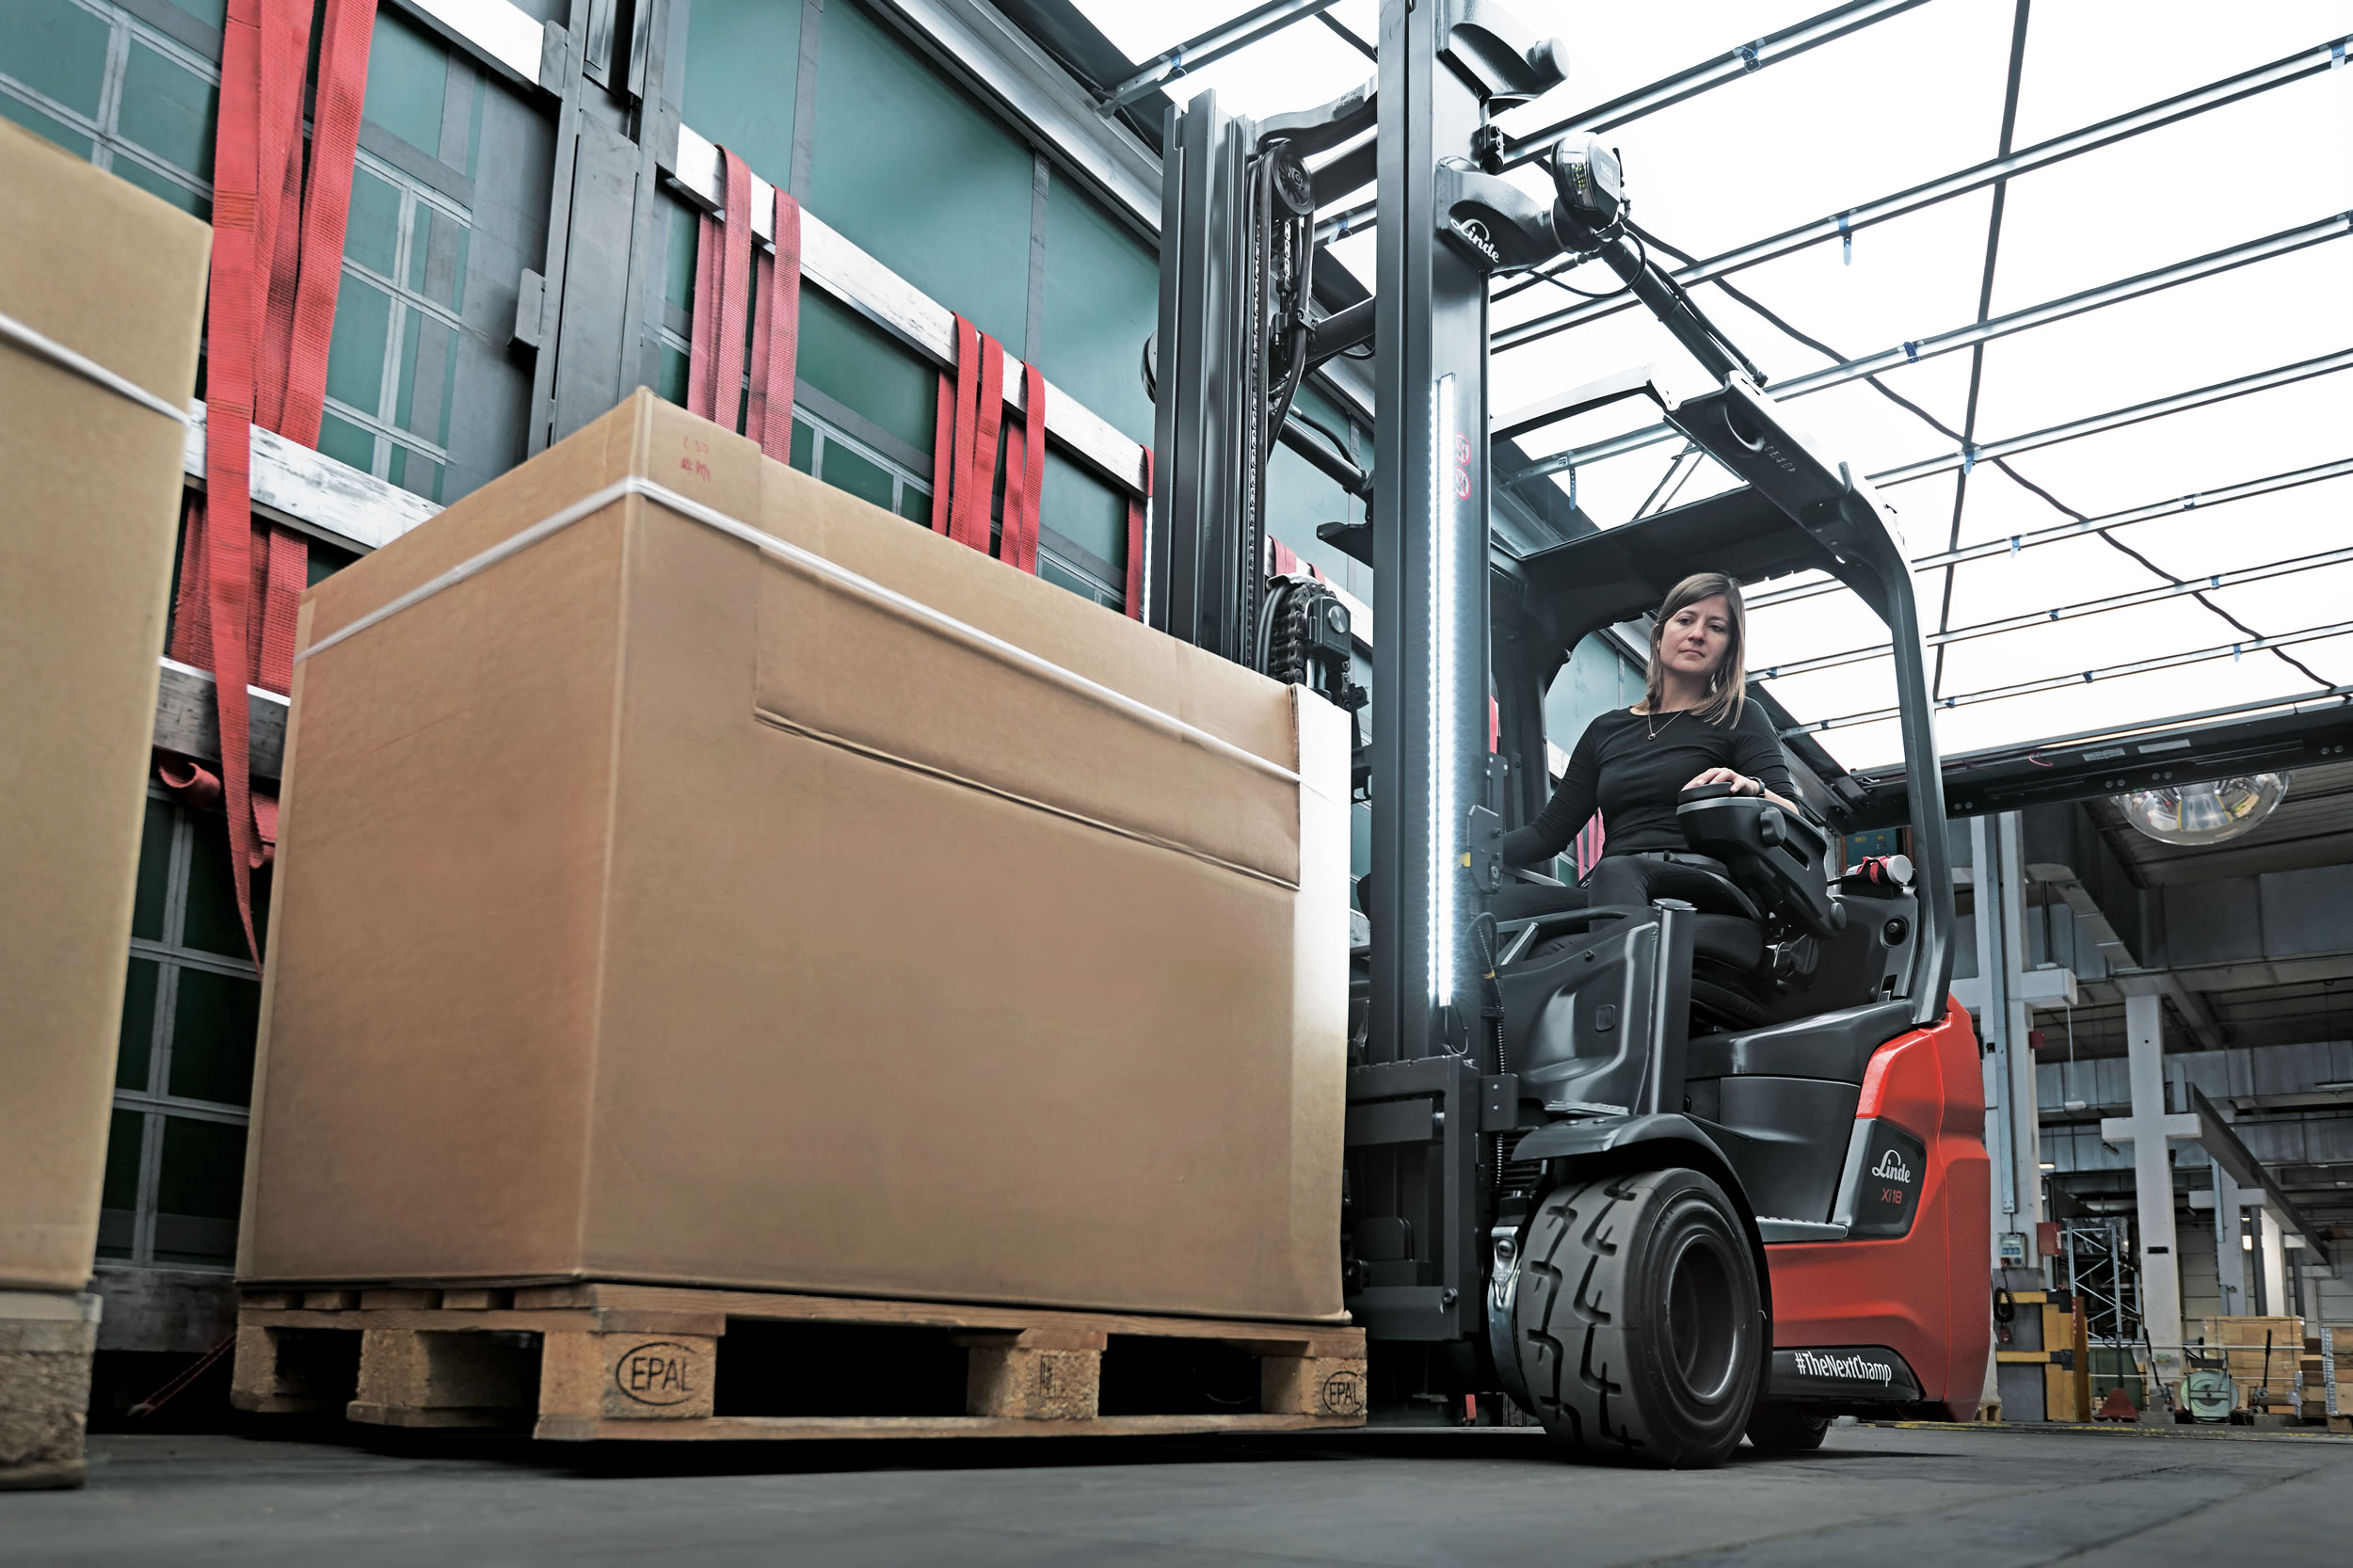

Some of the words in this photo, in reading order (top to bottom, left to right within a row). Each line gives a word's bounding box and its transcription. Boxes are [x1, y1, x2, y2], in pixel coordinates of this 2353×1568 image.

[1450, 218, 1499, 264] Linde
[1871, 1149, 1911, 1183] Linde
[631, 1357, 694, 1392] EPAL
[1795, 1351, 1892, 1387] #TheNextChamp
[1328, 1382, 1361, 1405] EPAL
